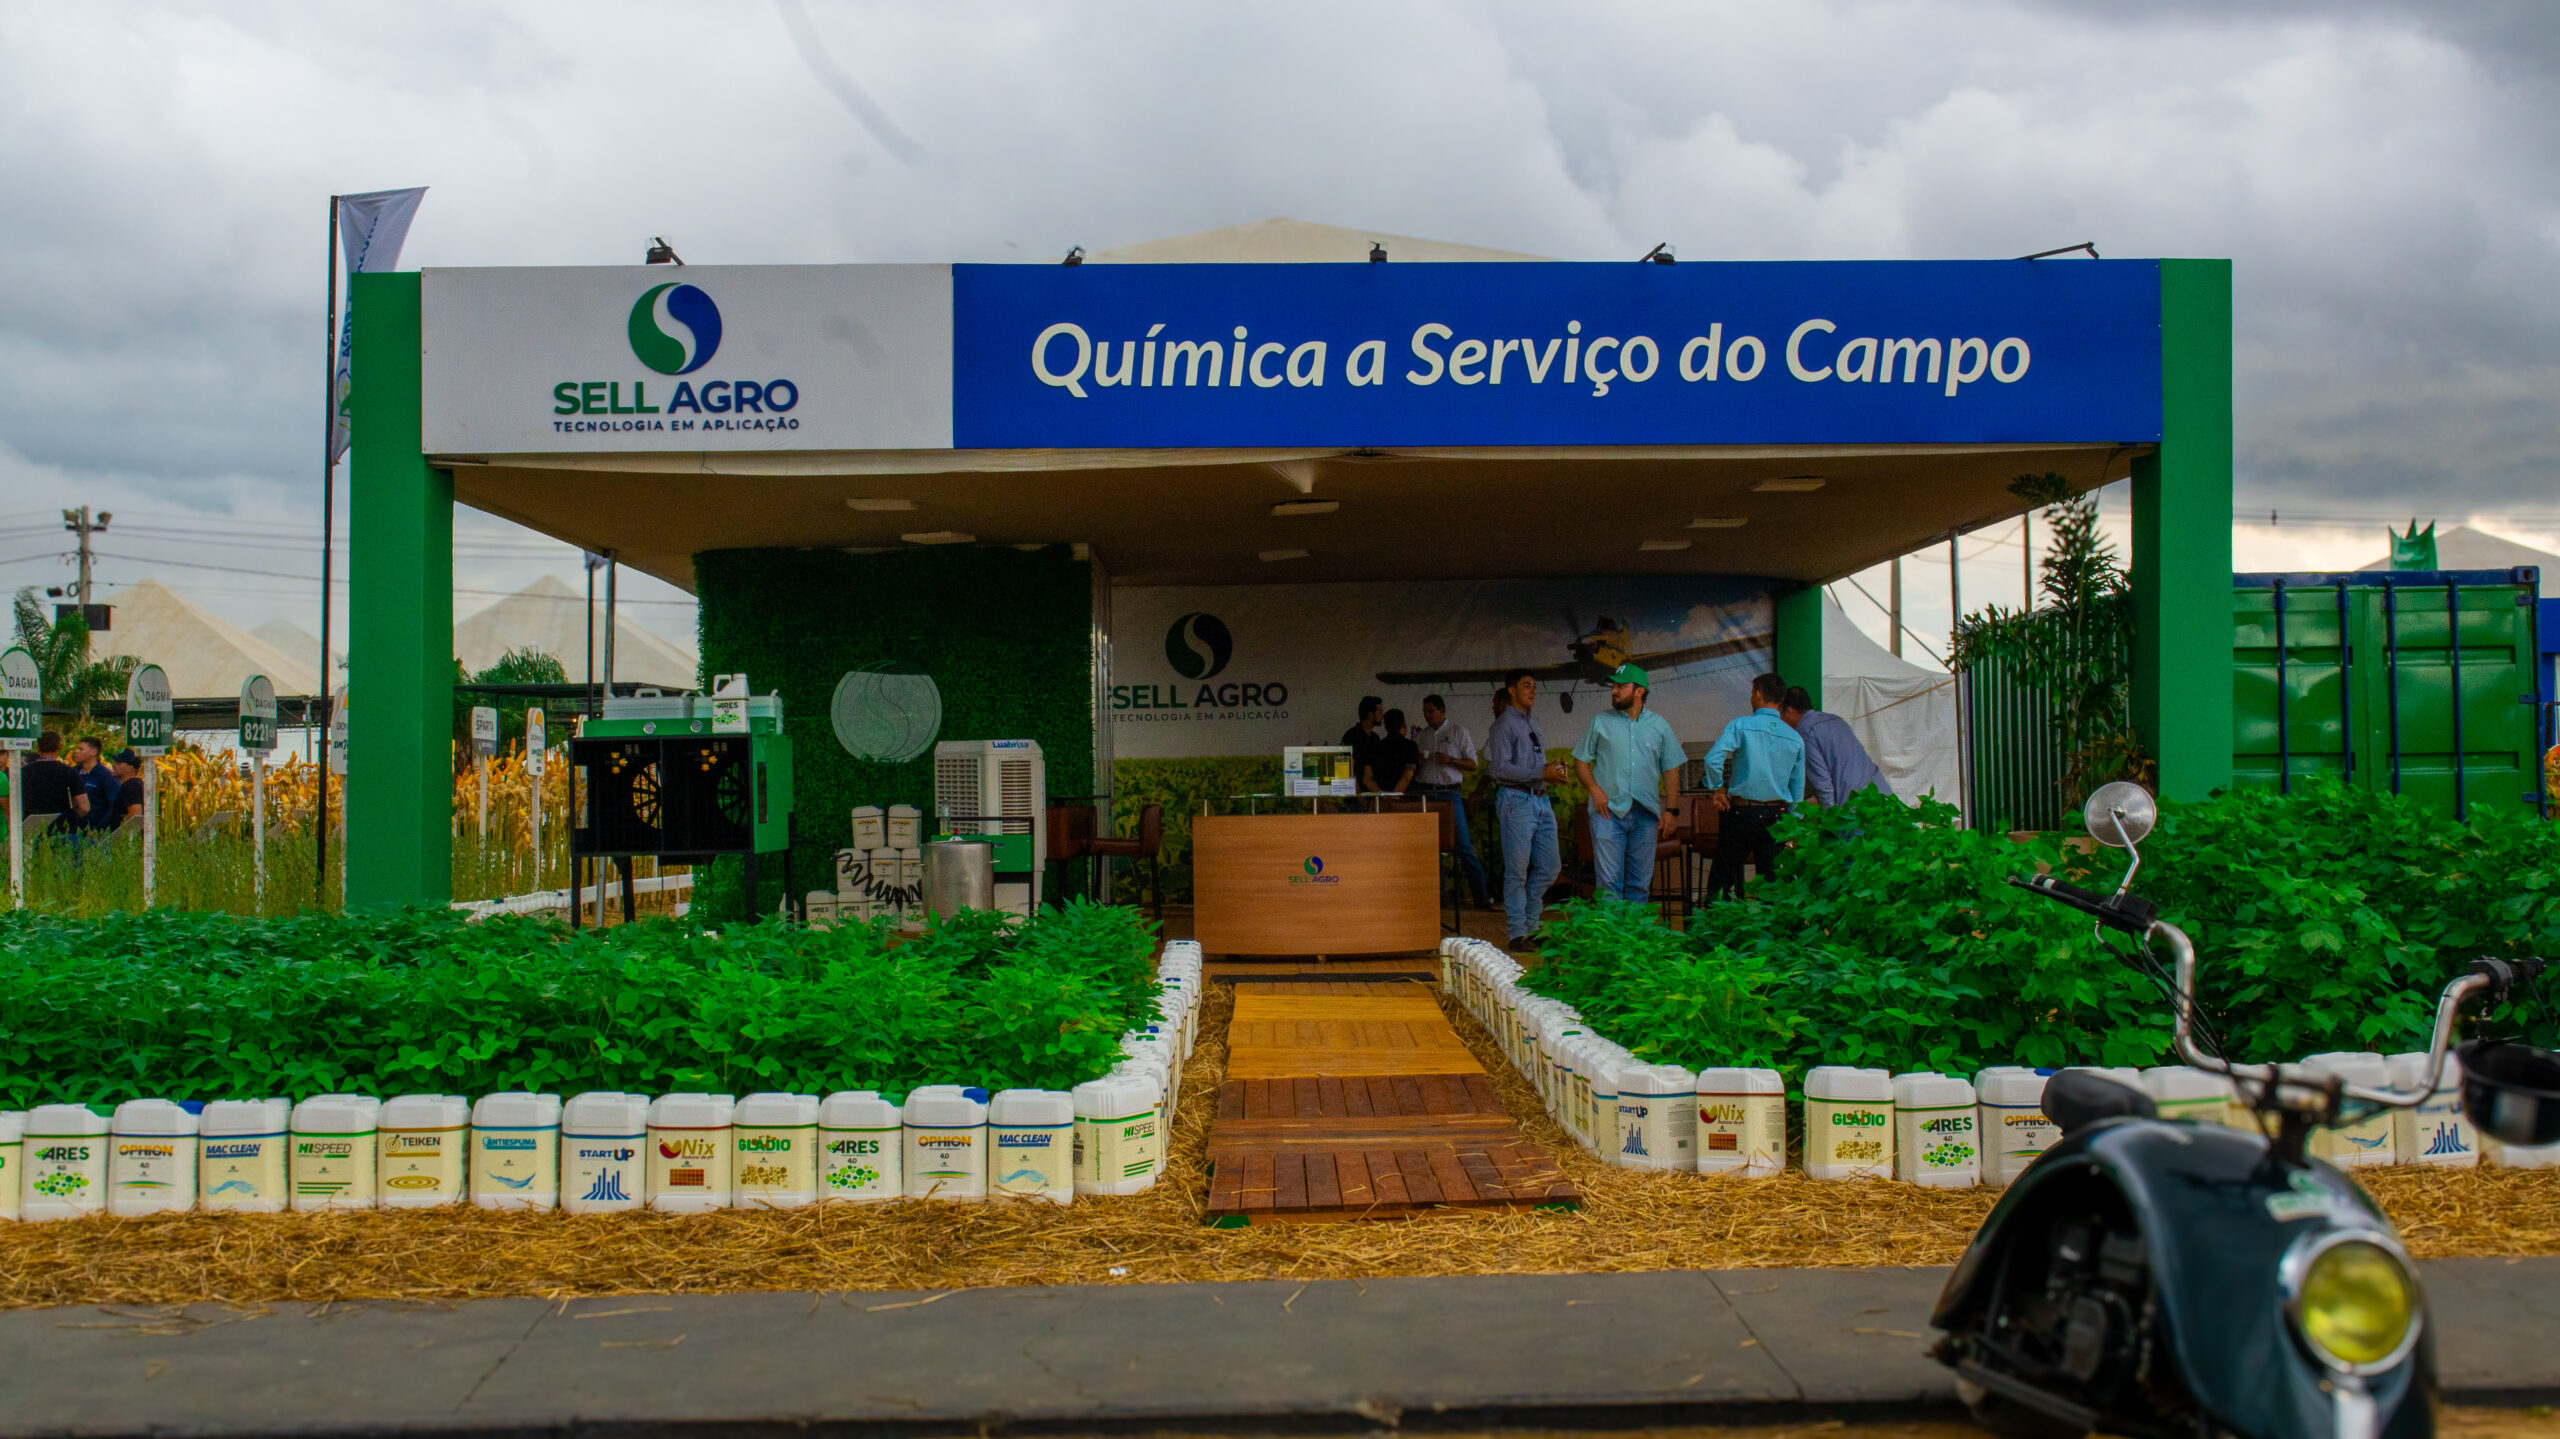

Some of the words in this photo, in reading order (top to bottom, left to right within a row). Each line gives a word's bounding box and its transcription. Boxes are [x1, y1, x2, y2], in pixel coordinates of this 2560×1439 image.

[1030, 321, 1325, 397] Química
[1345, 338, 1386, 387] a
[1405, 318, 1660, 397] Serviço
[1678, 320, 1766, 384] do
[1785, 317, 2031, 397] Campo
[553, 381, 660, 415] SELL
[667, 378, 799, 414] AGRO
[554, 419, 665, 433] TECNOLOGIA
[672, 419, 695, 431] EM
[702, 416, 800, 433] APLICAÇÃO
[9, 676, 38, 688] DAGMA
[1112, 684, 1187, 710] SELL
[1193, 681, 1289, 708] AGRO
[1113, 711, 1191, 723] TECNOLOGIA
[1197, 712, 1213, 721] EM
[1218, 709, 1290, 721] APLICAÇÃO
[131, 718, 159, 739] 8121
[244, 722, 269, 742] 8221
[992, 740, 1029, 749] Luabrisa
[1288, 875, 1309, 884] SELL
[1312, 875, 1339, 884] AGRO
[1717, 1103, 1745, 1121] Nix
[1832, 1112, 1886, 1127] GLADIO
[1930, 1116, 1973, 1132] ARES
[401, 1136, 441, 1147] TEIKEN
[738, 1138, 792, 1152] GLADIO
[917, 1135, 973, 1148] OPHION
[999, 1134, 1020, 1143] MAC
[1020, 1134, 1052, 1143] CLEAN
[42, 1146, 90, 1161] ARES
[118, 1143, 174, 1157] OPHION
[206, 1145, 229, 1154] MAC
[229, 1143, 261, 1154] CLEAN
[682, 1137, 716, 1156] Nix
[831, 1140, 880, 1154] ARES
